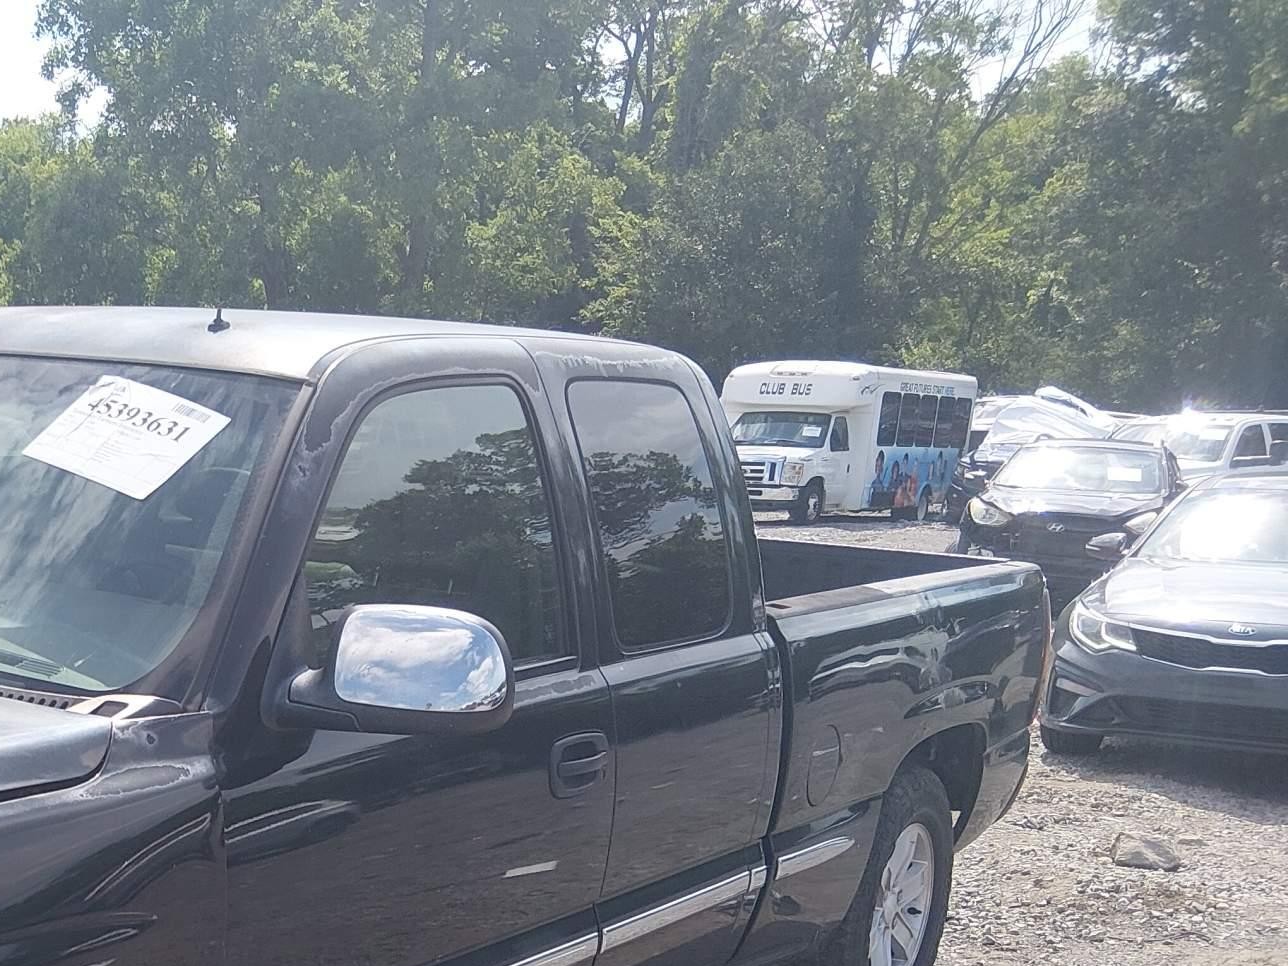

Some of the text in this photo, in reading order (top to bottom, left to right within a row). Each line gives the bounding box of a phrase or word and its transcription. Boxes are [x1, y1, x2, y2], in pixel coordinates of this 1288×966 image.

[759, 382, 813, 396] CLUB BUS
[88, 398, 191, 442] 45393631
